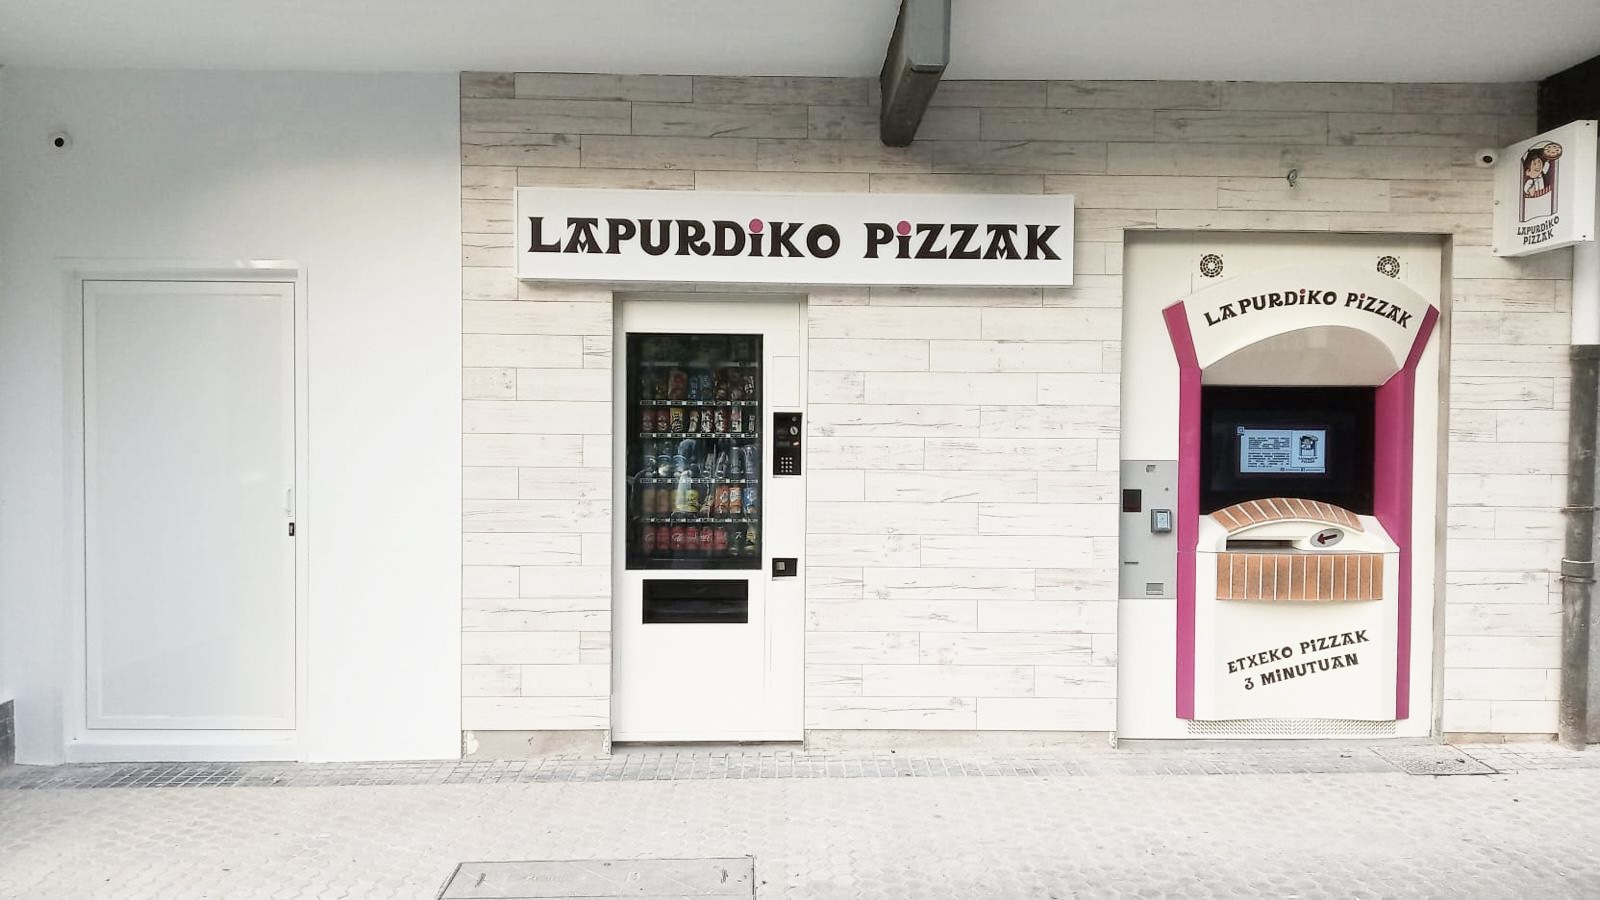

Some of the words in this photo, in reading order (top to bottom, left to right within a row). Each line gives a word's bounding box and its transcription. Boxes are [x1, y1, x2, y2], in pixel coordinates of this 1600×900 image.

[528, 217, 841, 259] LAPURDiKO
[864, 221, 1062, 260] PiZZAK
[1227, 646, 1293, 674] ETXEKO
[1244, 677, 1255, 691] 3
